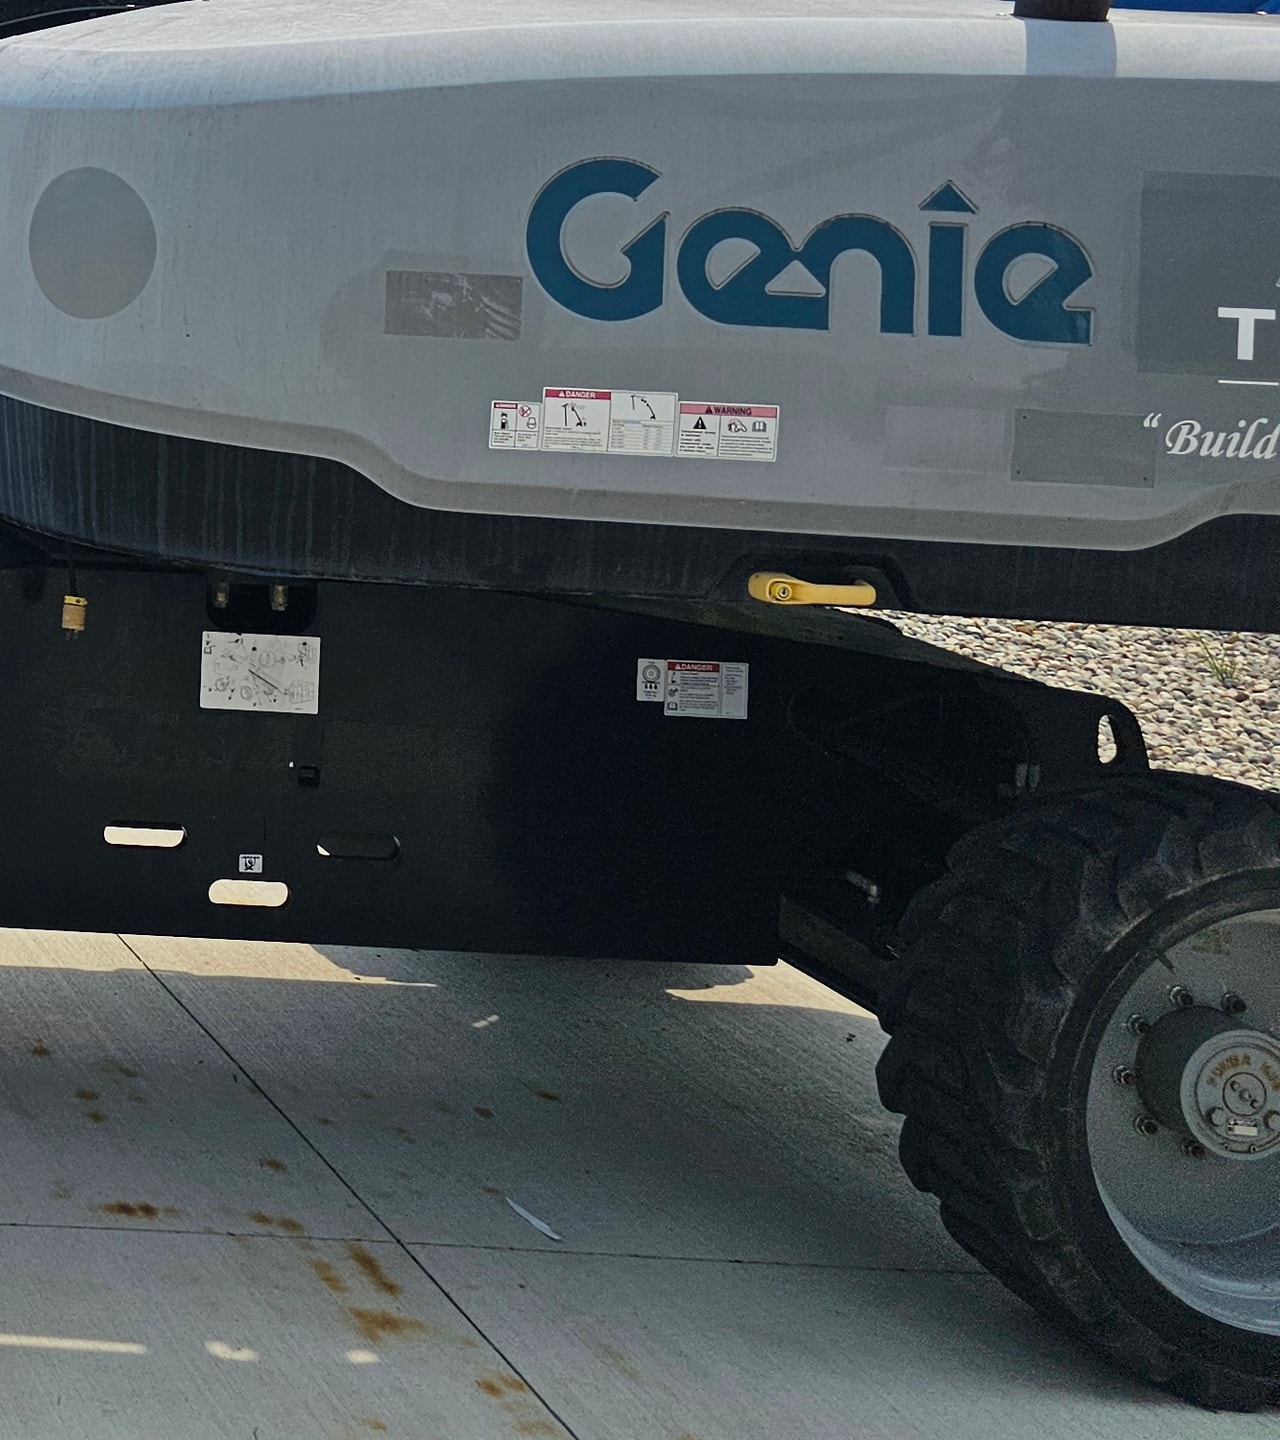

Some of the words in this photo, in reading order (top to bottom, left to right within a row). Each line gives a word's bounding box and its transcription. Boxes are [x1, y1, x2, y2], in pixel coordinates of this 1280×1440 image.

[526, 157, 1095, 346] Genie
[566, 390, 596, 398] DANGER
[714, 406, 752, 416] WARNING
[681, 664, 713, 672] DANGER
